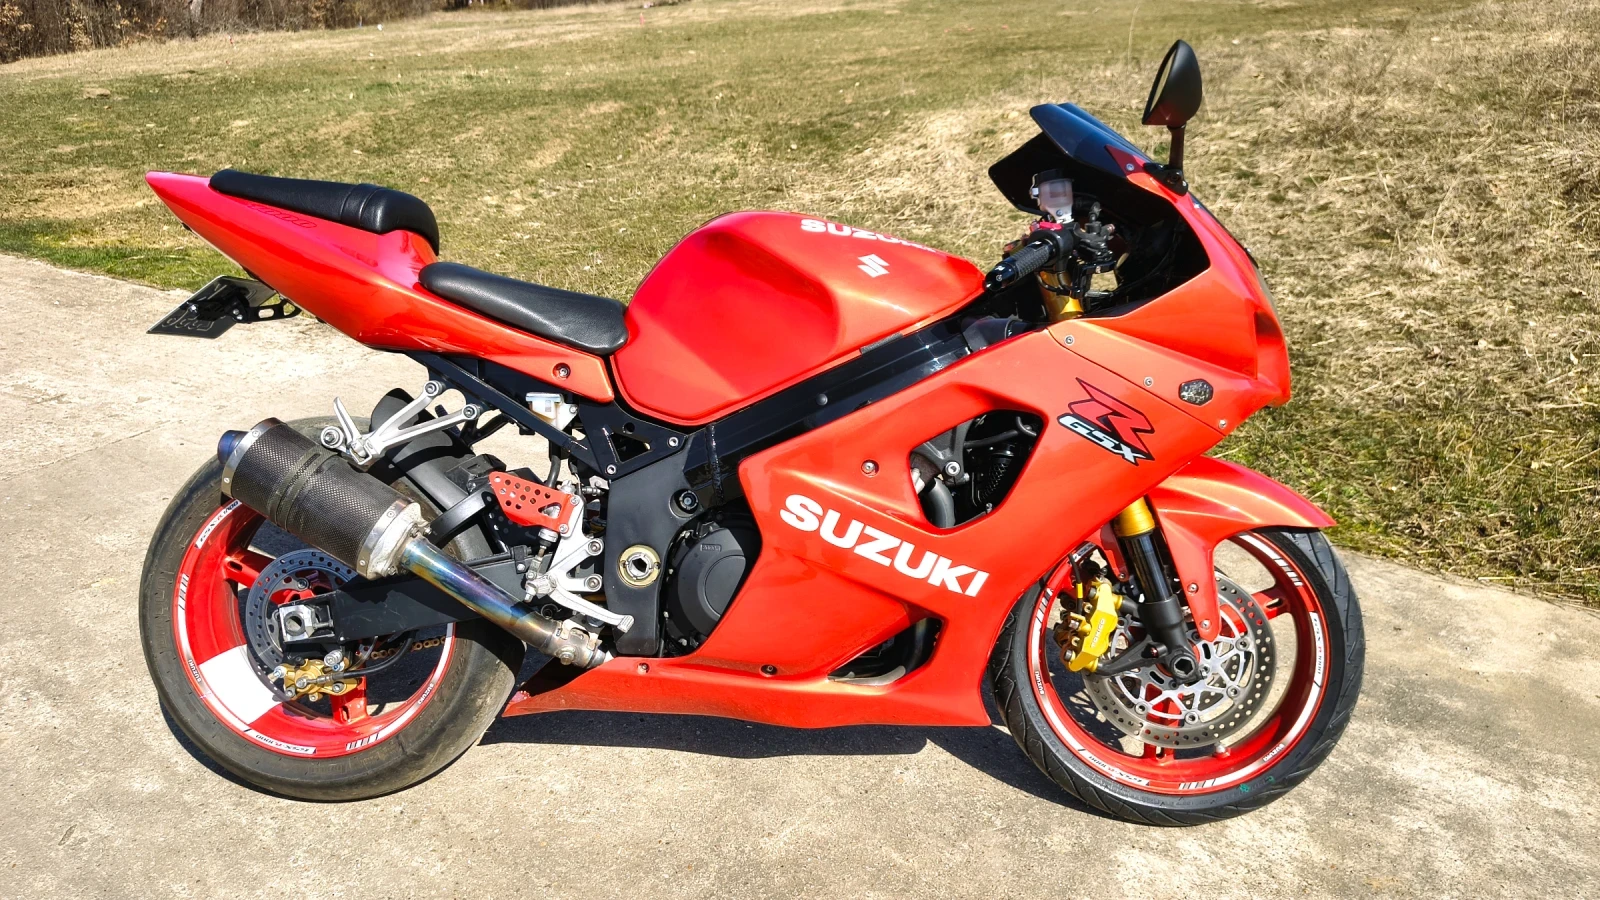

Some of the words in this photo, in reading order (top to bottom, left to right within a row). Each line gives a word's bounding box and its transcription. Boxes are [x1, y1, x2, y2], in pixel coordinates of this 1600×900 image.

[1057, 412, 1147, 466] GSX
[779, 494, 990, 597] SUZUKI
[187, 658, 202, 683] SUZUKI
[1034, 670, 1045, 695] SUZUKI
[417, 682, 435, 705] SUZUKI
[1262, 743, 1285, 762] SUZUKI
